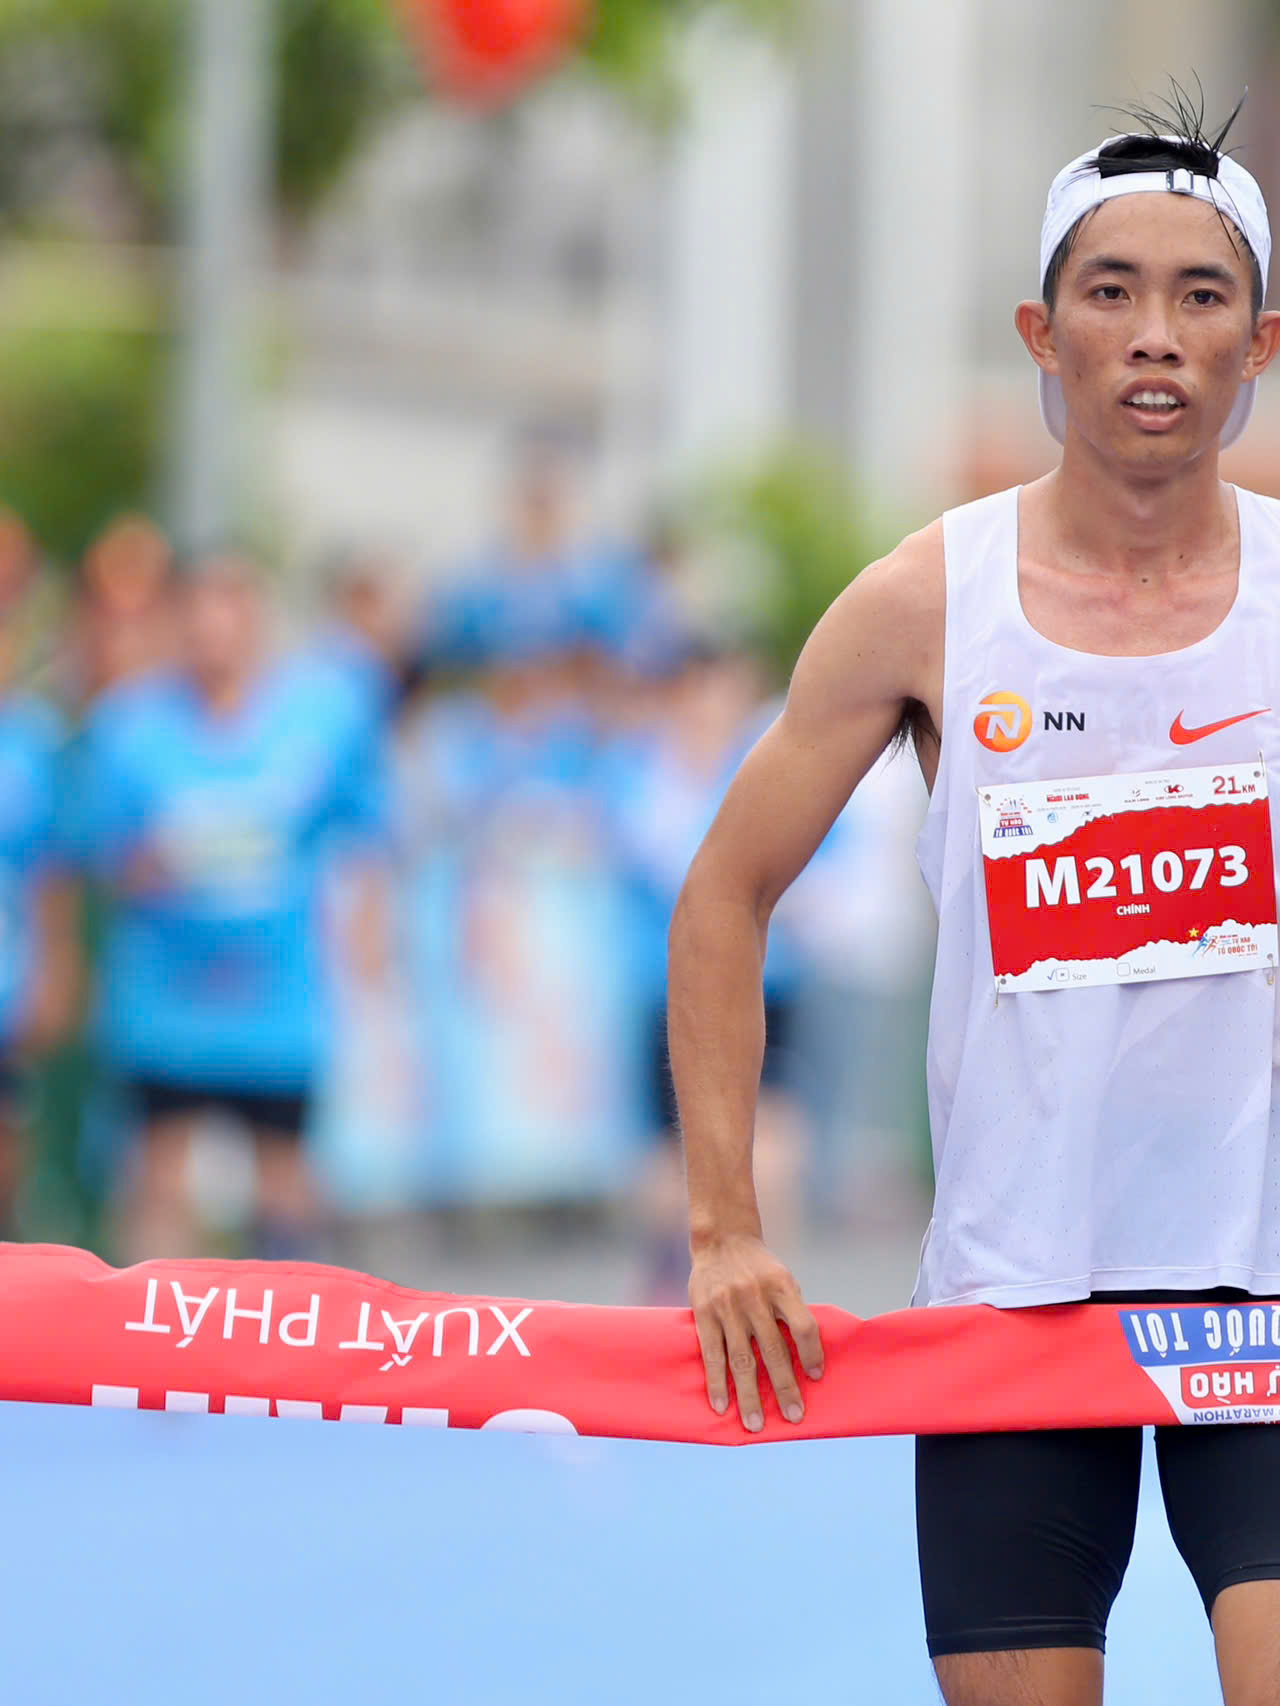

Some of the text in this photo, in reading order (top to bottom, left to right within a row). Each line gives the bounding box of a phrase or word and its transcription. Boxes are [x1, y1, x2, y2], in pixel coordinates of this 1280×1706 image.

[1043, 711, 1086, 732] NN
[1025, 845, 1249, 909] M21073
[1116, 903, 1151, 916] CHÍNH
[1133, 965, 1156, 975] Medal
[124, 1277, 534, 1371] XUẤT PHÁT
[1129, 1311, 1190, 1359] TÔI
[1189, 1370, 1255, 1404] HÀO
[1193, 1407, 1275, 1423] MARATHON
